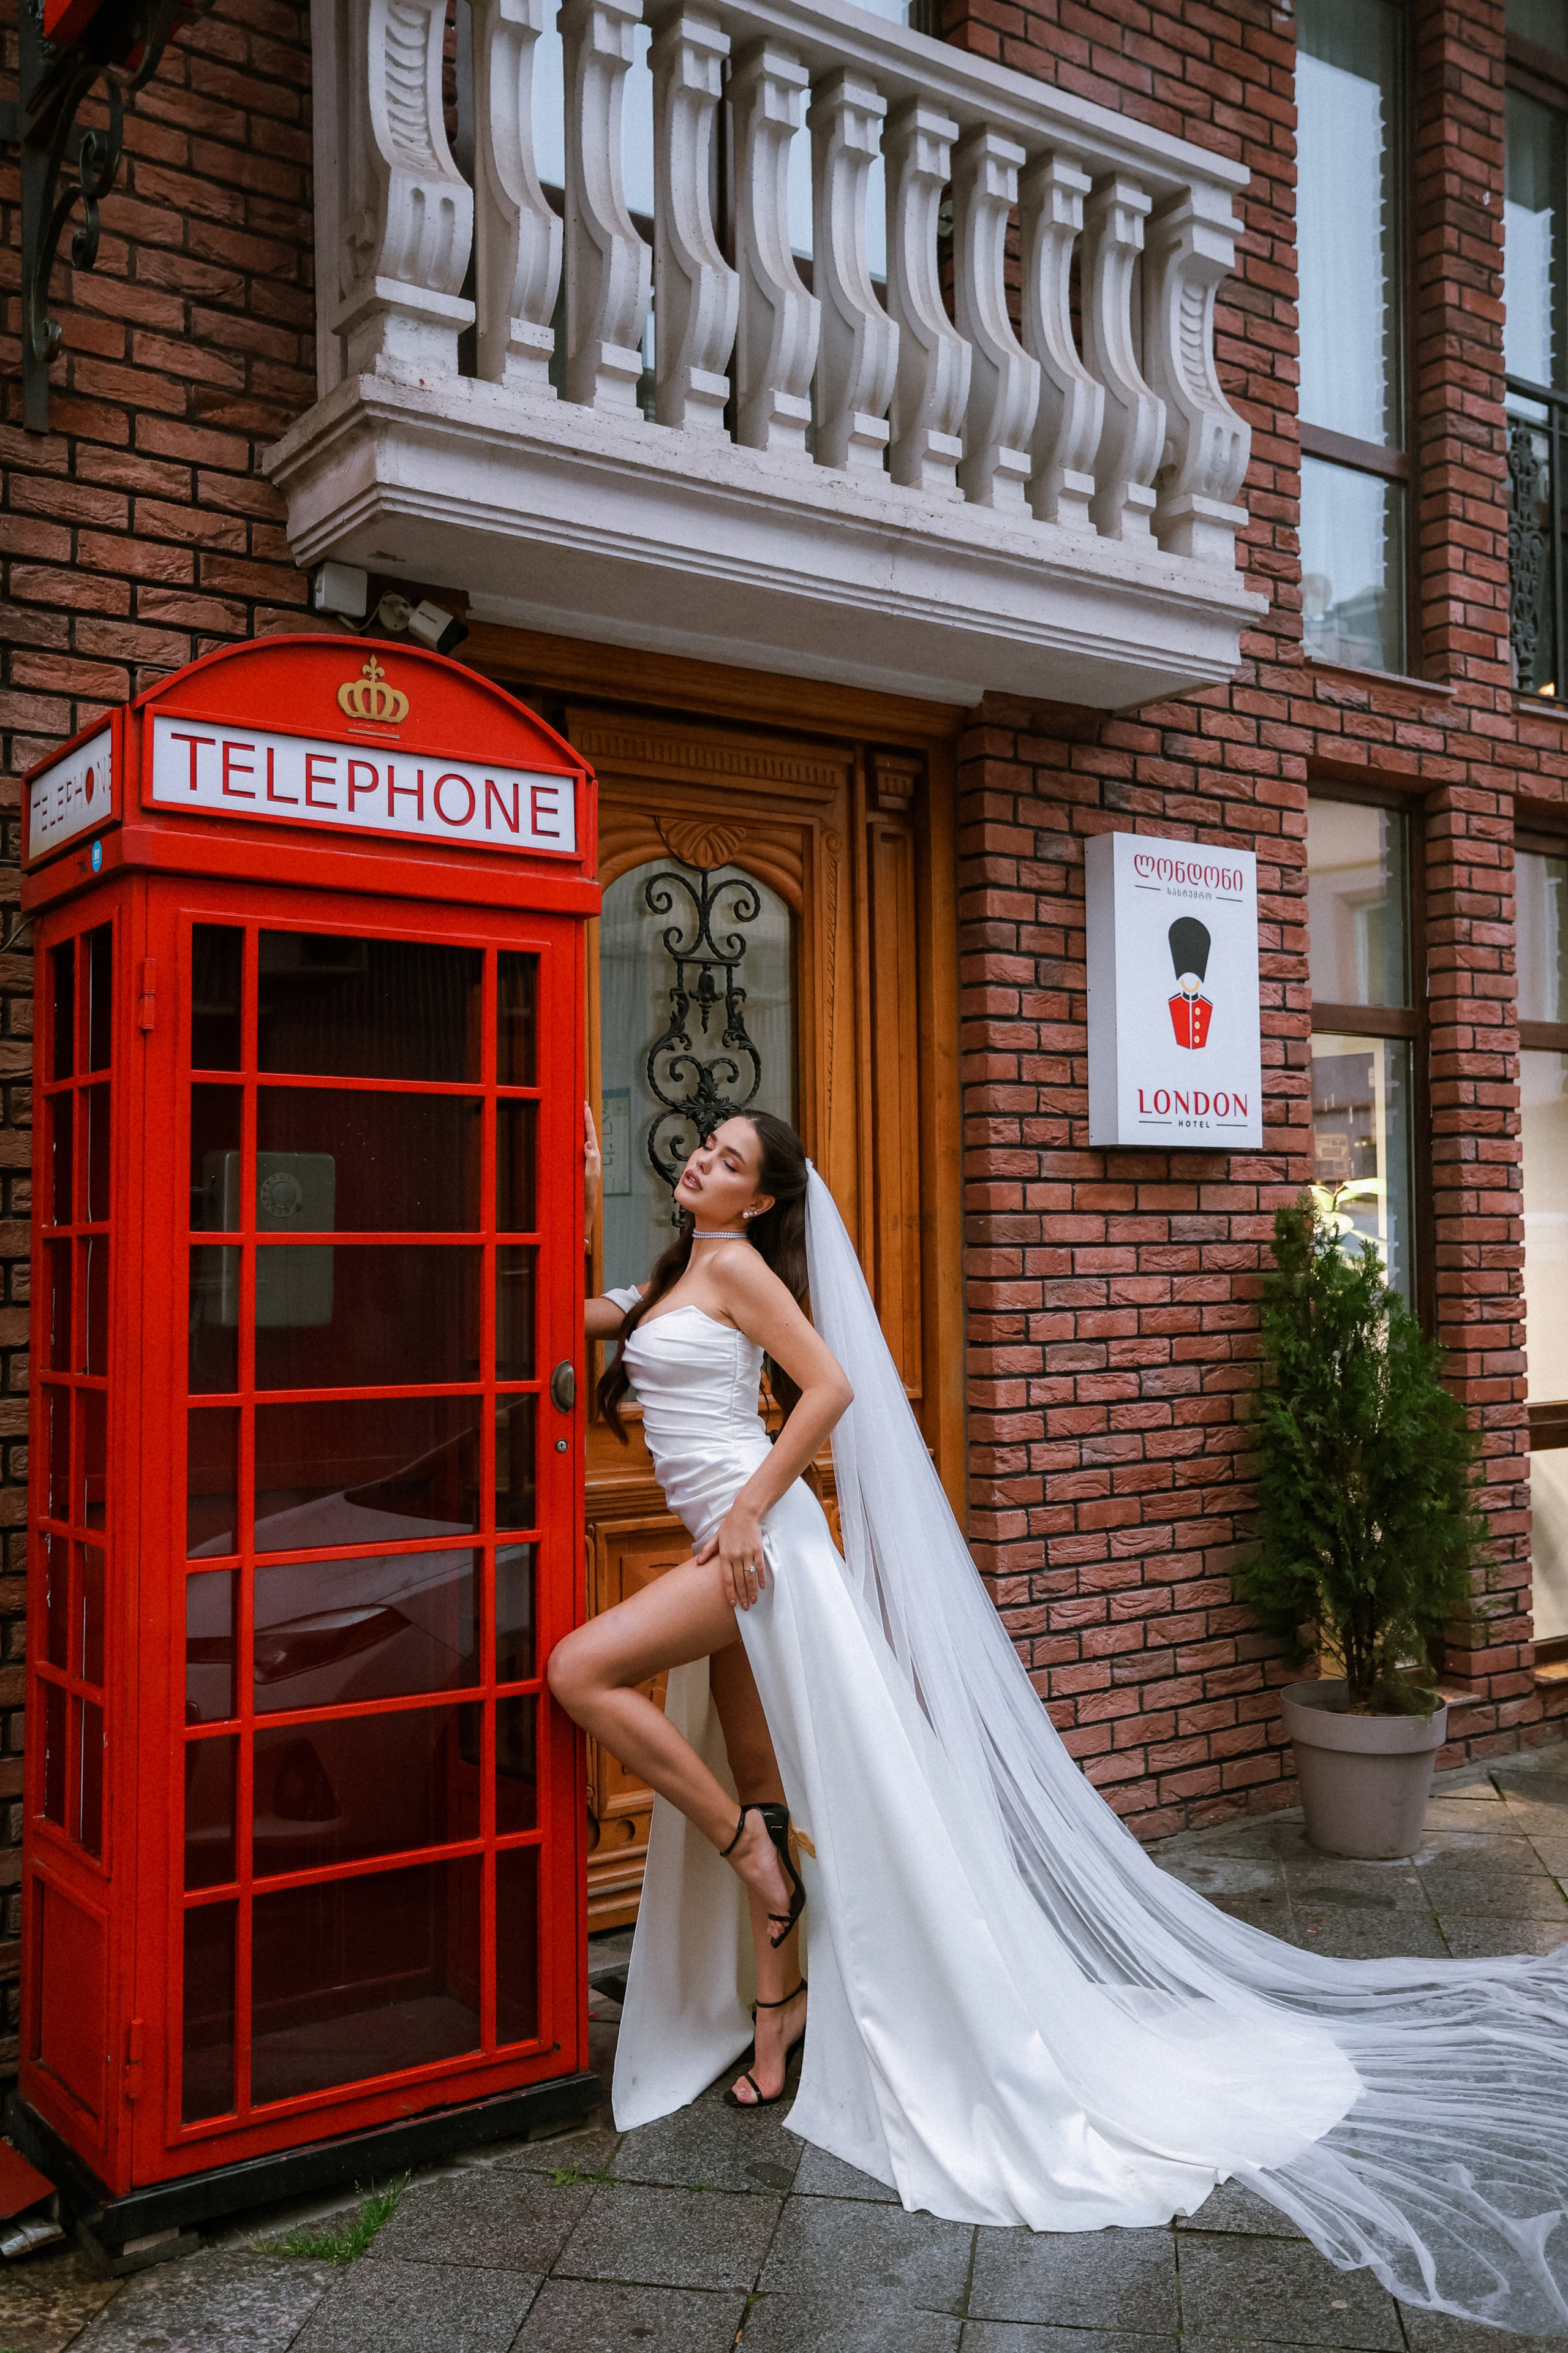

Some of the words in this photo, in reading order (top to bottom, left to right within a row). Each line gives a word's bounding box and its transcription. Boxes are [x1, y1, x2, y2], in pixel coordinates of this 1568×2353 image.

[171, 732, 560, 838] TELEPHONE
[1134, 854, 1243, 892] ლონდონი
[1167, 888, 1212, 901] სასტუმრო
[1137, 1089, 1248, 1117] LONDON
[1178, 1120, 1210, 1128] HOTEL
